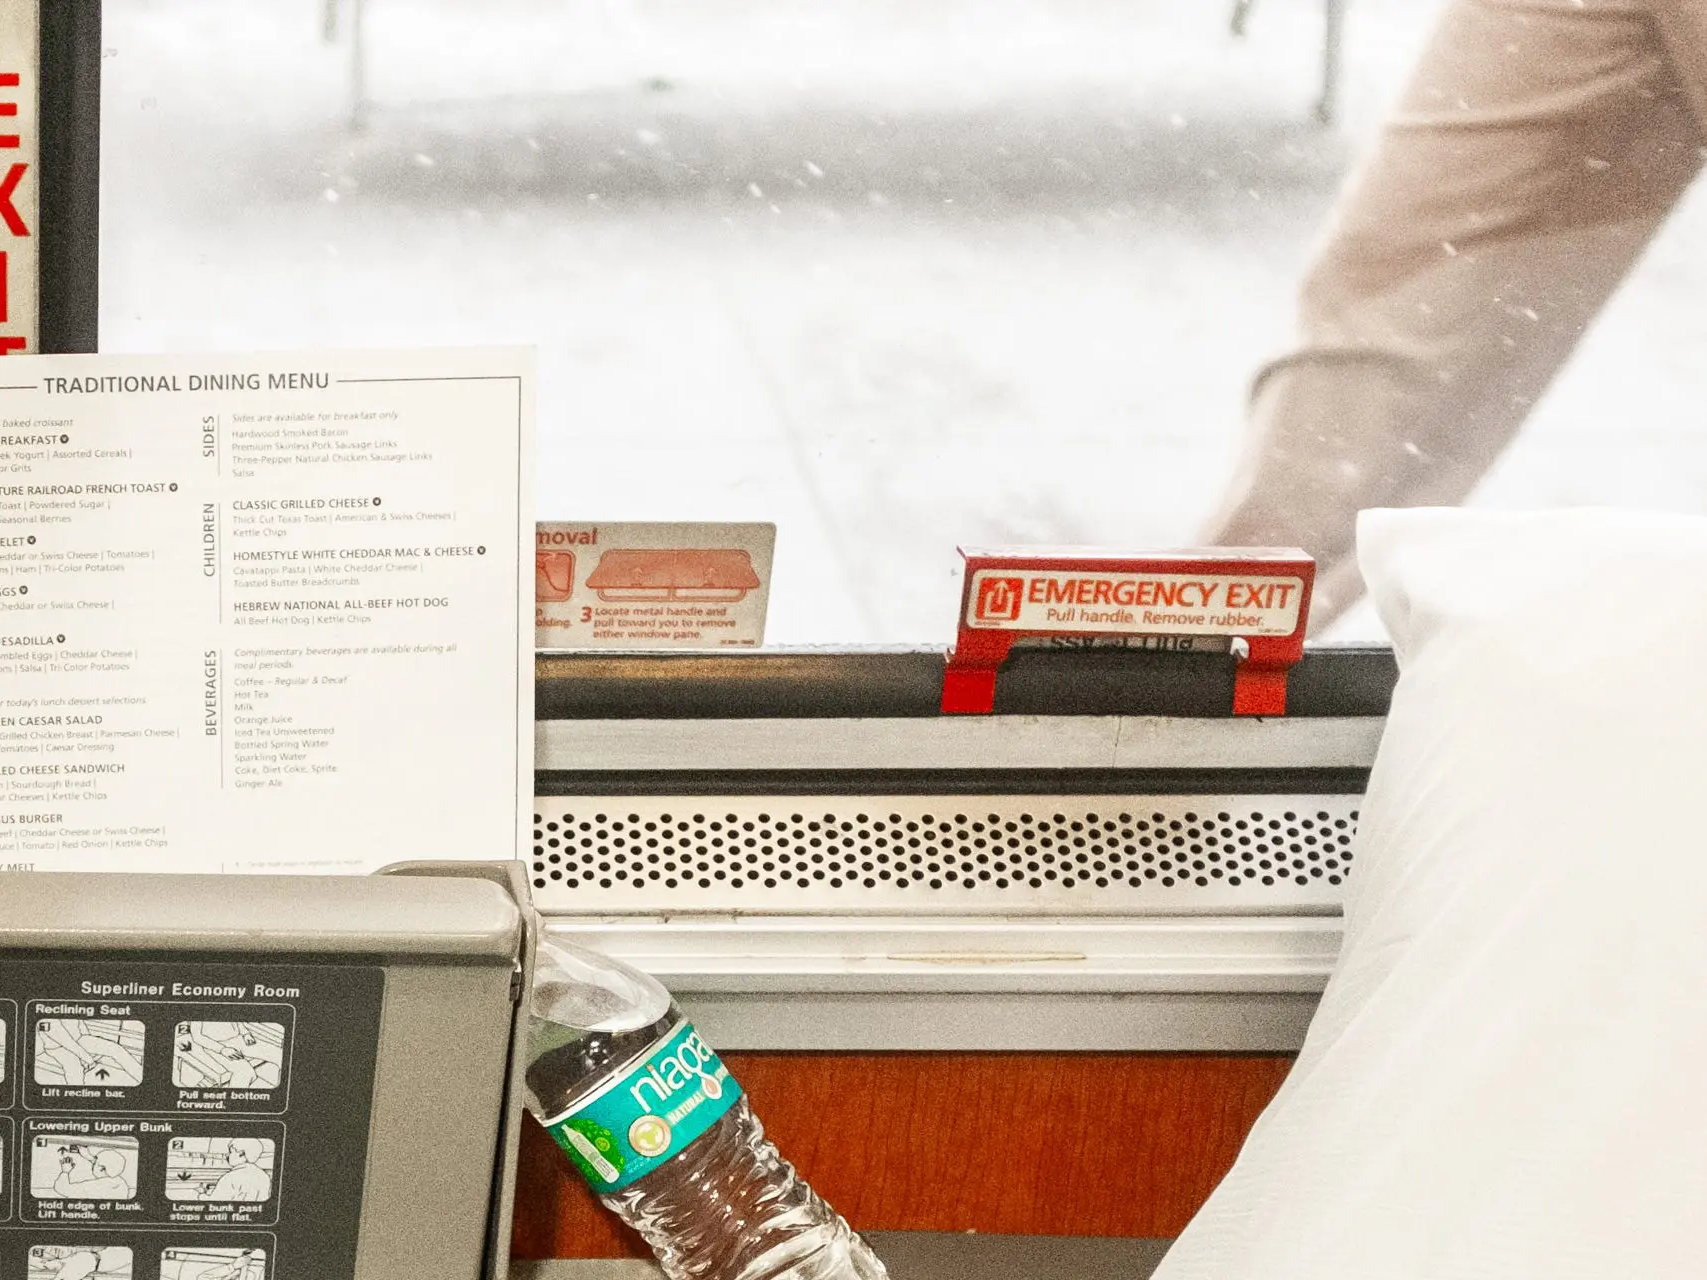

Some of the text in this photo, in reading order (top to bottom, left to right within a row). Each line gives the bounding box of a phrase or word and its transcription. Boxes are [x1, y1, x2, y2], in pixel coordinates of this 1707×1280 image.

[44, 372, 328, 393] TRADITIONAL DINING MENU
[203, 416, 214, 458] SIDES
[27, 485, 82, 494] RAILROAD
[85, 484, 127, 493] FRENCH
[131, 483, 166, 492] TOAST
[232, 498, 369, 509] CLASSIC GRILLED CHEESE
[203, 503, 215, 577] CHILDREN
[233, 546, 474, 560] HOMESTYLE WHITE CHEDDAR MAC & CHEESE
[1028, 578, 1294, 608] EMERGENCY EXIT
[233, 597, 448, 611] HEBREW NATIONAL ALL-BEEF HOT DOG
[580, 607, 726, 622] 3 Locate metal handle and
[1046, 608, 1264, 626] Pull handle. Remove rubber.
[594, 618, 614, 628] pull
[618, 619, 655, 627] toward
[658, 620, 678, 628] you
[594, 630, 701, 640] either window pane.
[205, 650, 217, 736] BEVERAGES
[18, 716, 62, 725] CAESAR
[65, 715, 102, 724] SALAD
[234, 715, 292, 724] Orange Juice
[19, 765, 59, 774] CHEESE
[64, 764, 125, 773] SANDWICH
[19, 814, 62, 823] BURGER
[81, 981, 299, 997] Superliner Economy Room
[35, 1004, 130, 1016] Reclining Seat
[41, 1088, 60, 1096] Lift
[105, 1089, 124, 1097] bar.
[202, 1092, 226, 1100] seat
[230, 1092, 270, 1100] bottom
[176, 1101, 225, 1110] forward.
[29, 1122, 172, 1133] Lowering Upper Bunk
[38, 1201, 143, 1211] Hold edge of bunk.
[172, 1204, 262, 1214] Lower bunk past
[37, 1210, 99, 1220] Lift handle.
